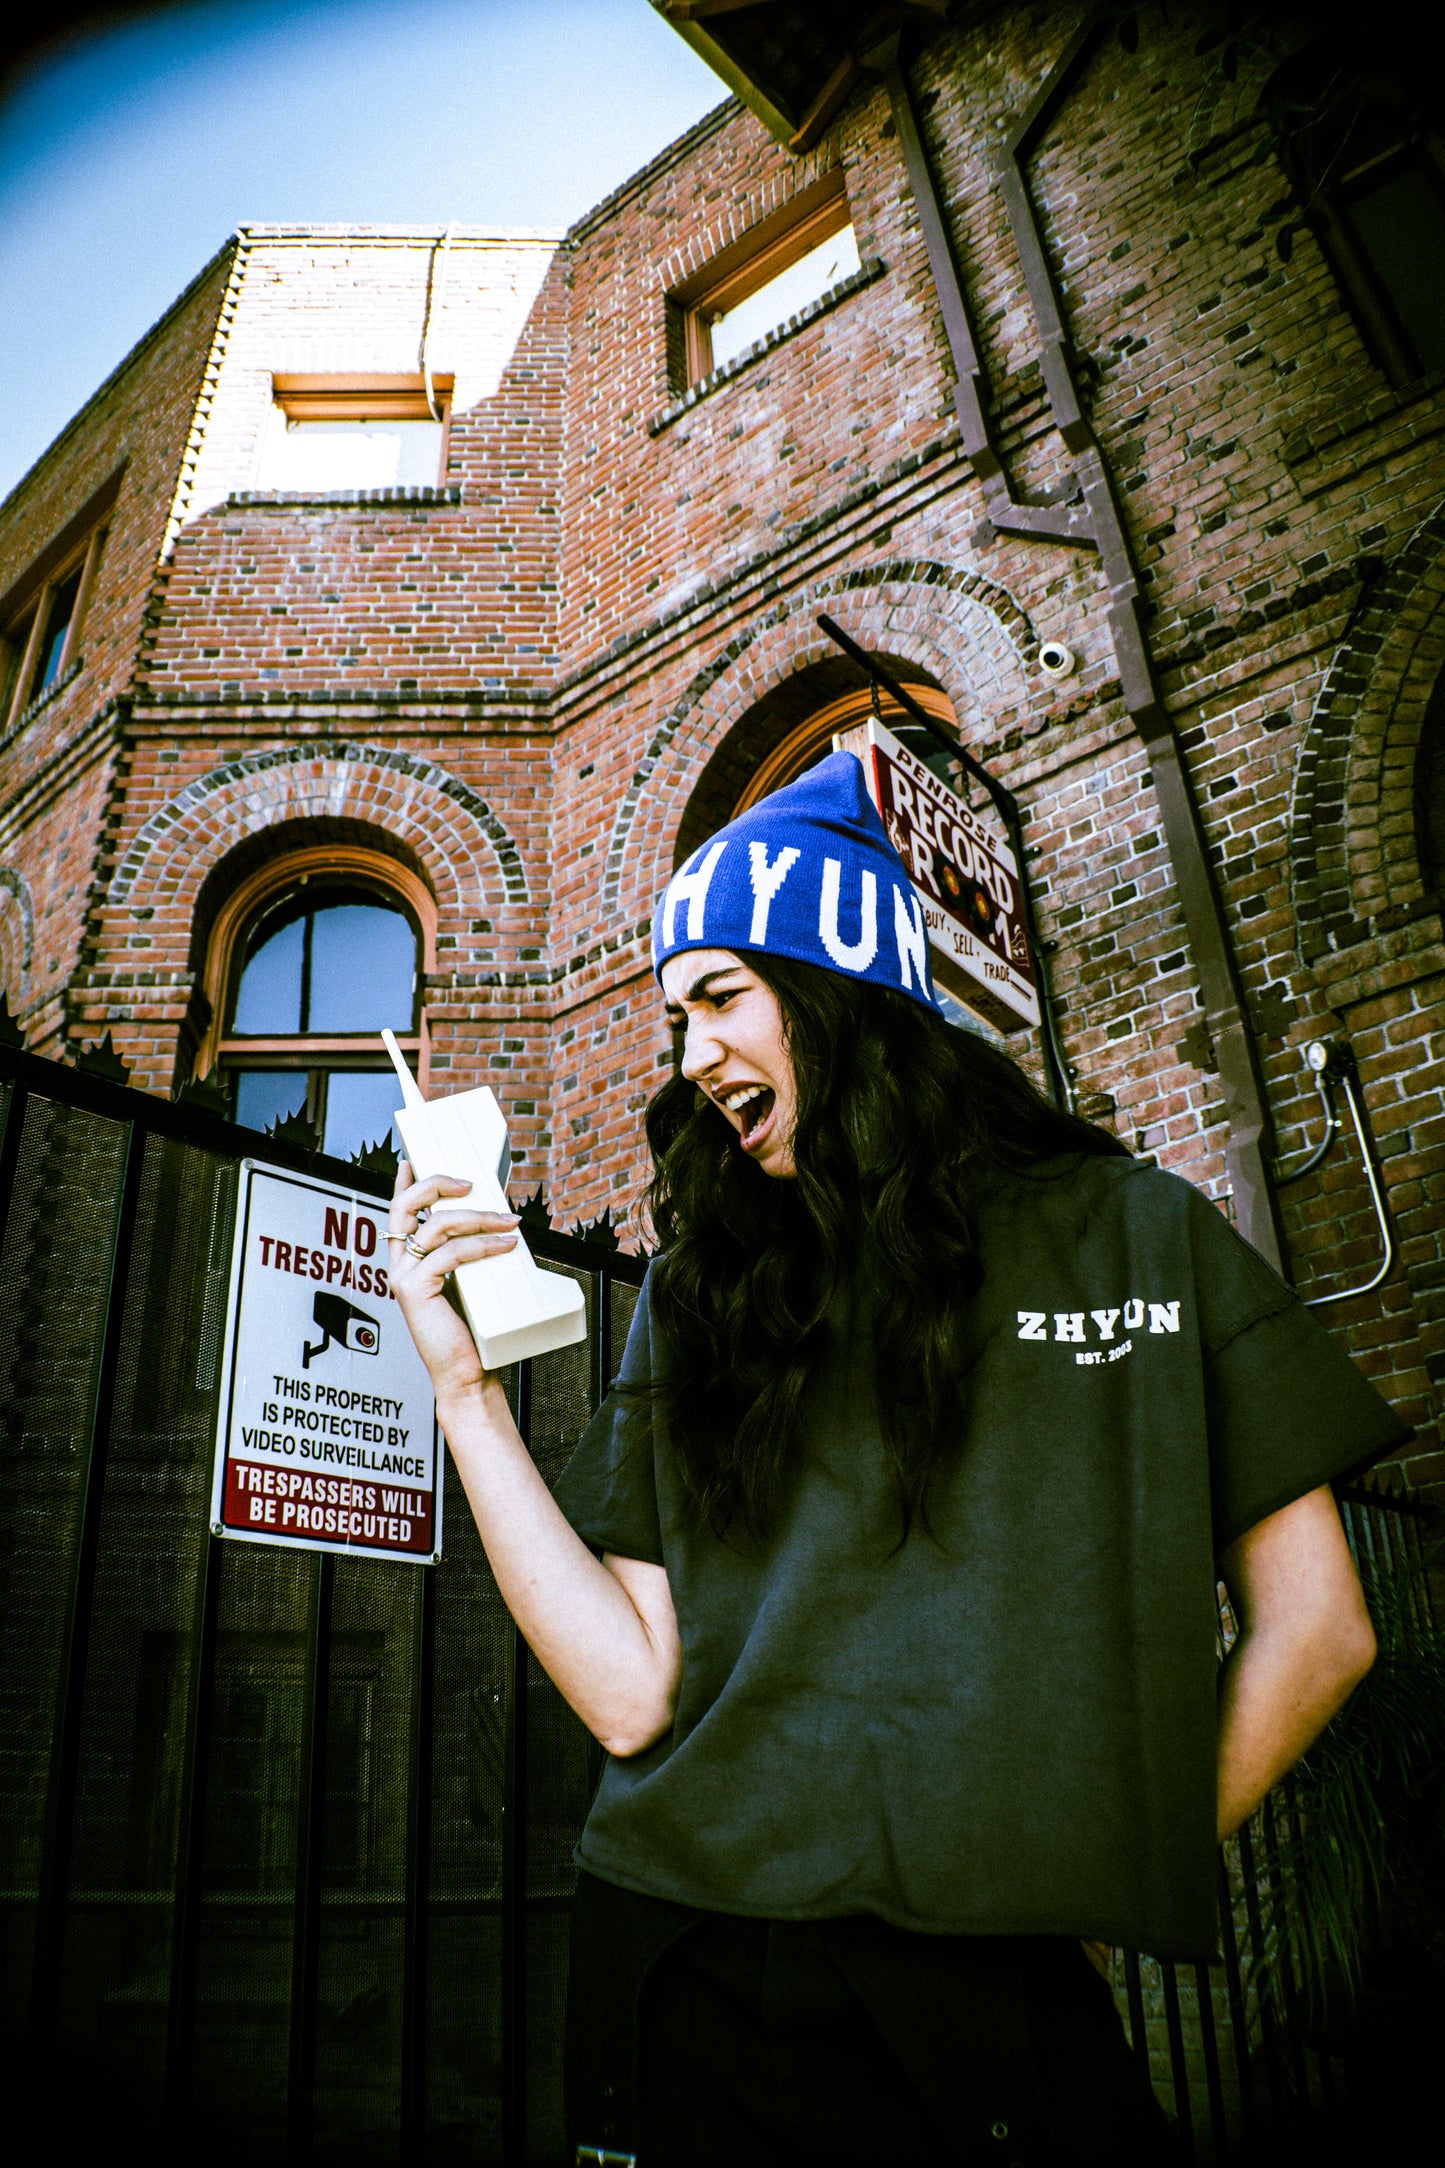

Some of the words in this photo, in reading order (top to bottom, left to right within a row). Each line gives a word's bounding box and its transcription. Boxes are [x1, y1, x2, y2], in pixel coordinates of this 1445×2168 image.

[896, 748, 998, 852] PENROSE
[890, 764, 1014, 915] RECORD
[651, 841, 931, 1001] HYUN
[925, 909, 946, 930] BUY
[953, 932, 974, 956] SELL
[983, 962, 1010, 982] TRADE
[323, 1206, 377, 1258] NO
[1017, 1298, 1181, 1343] ZHYUN
[1075, 1351, 1106, 1365] EST.
[273, 1375, 311, 1401] THIS
[315, 1384, 403, 1420] PROPERTY
[262, 1402, 279, 1424] IS
[283, 1406, 384, 1443] PROTECTED
[388, 1427, 410, 1448] BY
[242, 1426, 296, 1456] VIDEO
[300, 1438, 425, 1479] SURVEILLANCE
[235, 1465, 376, 1511] TRESPASSERS
[381, 1489, 426, 1518] WILL
[249, 1496, 277, 1524] BE
[282, 1501, 412, 1543] PROSECUTED
